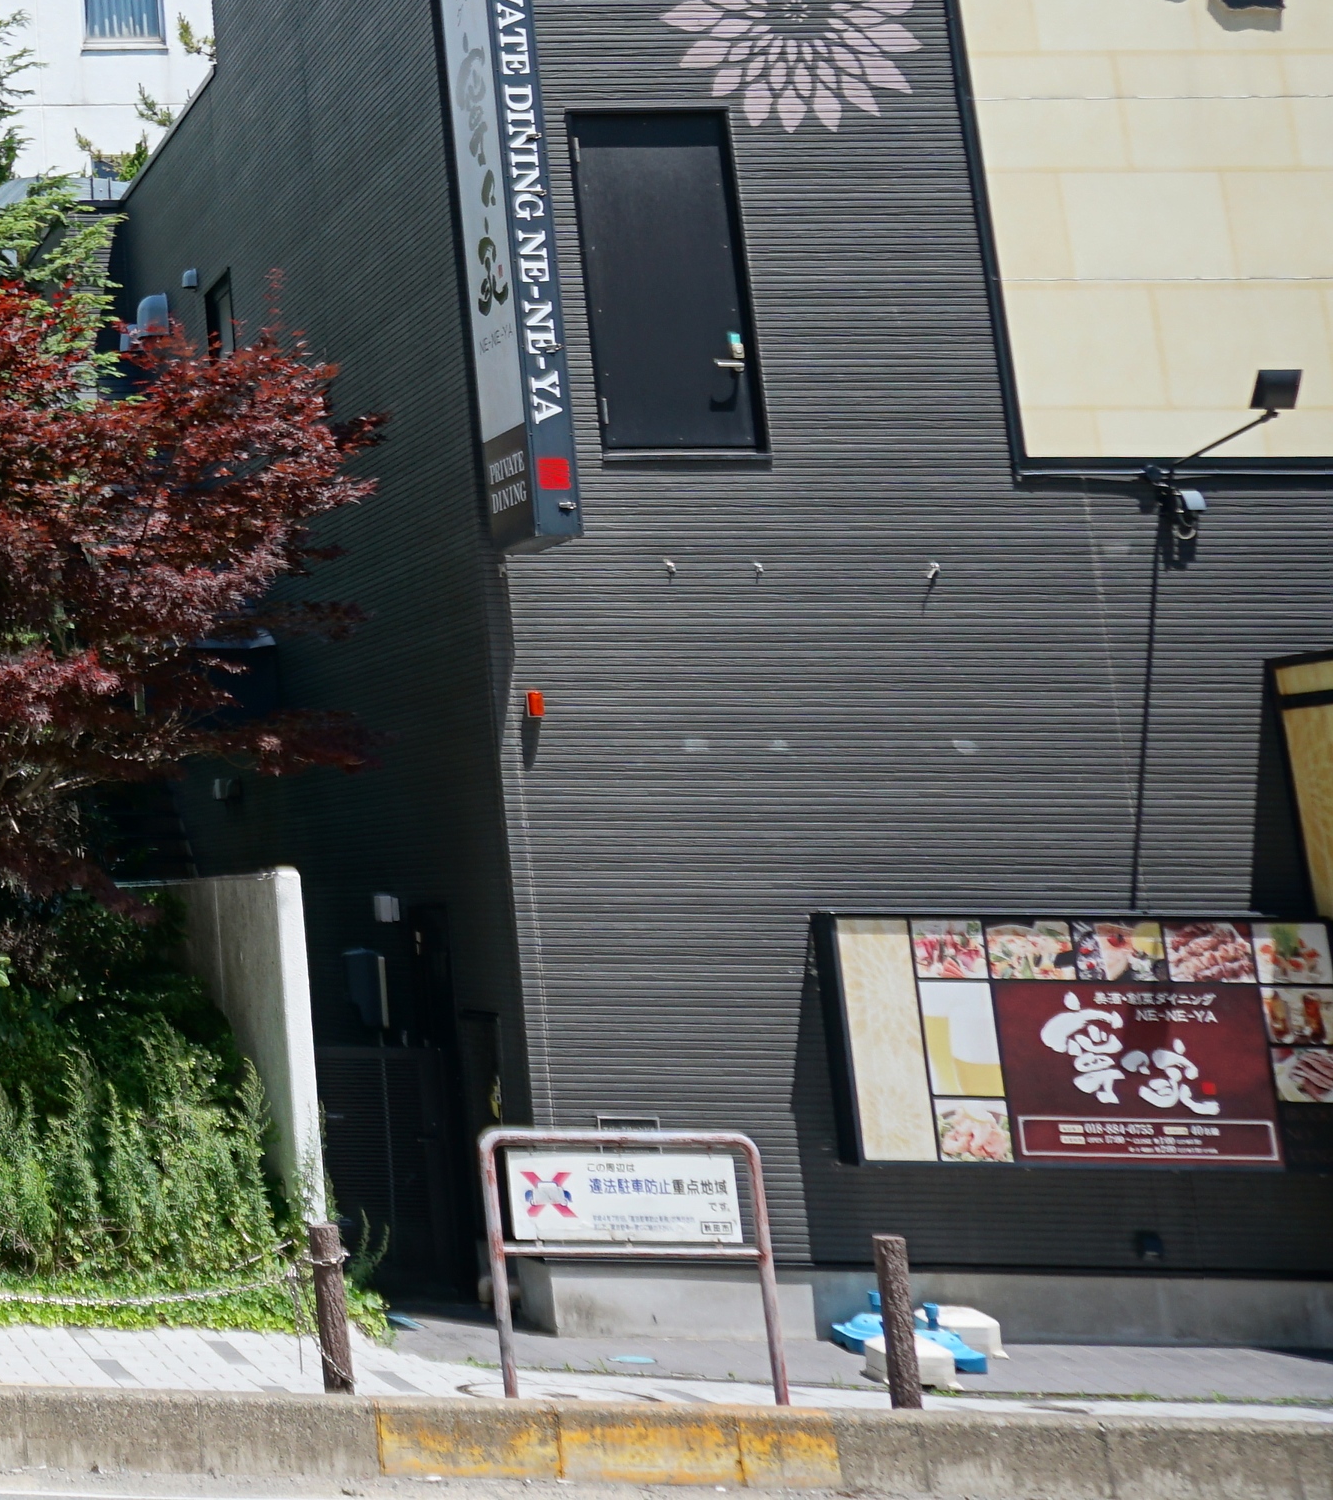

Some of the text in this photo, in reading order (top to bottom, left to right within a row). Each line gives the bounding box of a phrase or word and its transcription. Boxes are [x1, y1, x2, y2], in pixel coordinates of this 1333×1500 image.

[503, 84, 546, 221] DINING
[479, 322, 514, 356] NE-NE-YA
[517, 229, 564, 425] NE-NE-YA
[488, 450, 526, 486] PRIVATE
[491, 480, 527, 515] DINING
[1135, 1009, 1219, 1024] NE-NE-YA
[588, 1178, 729, 1196] 違法駐車防止重点地域
